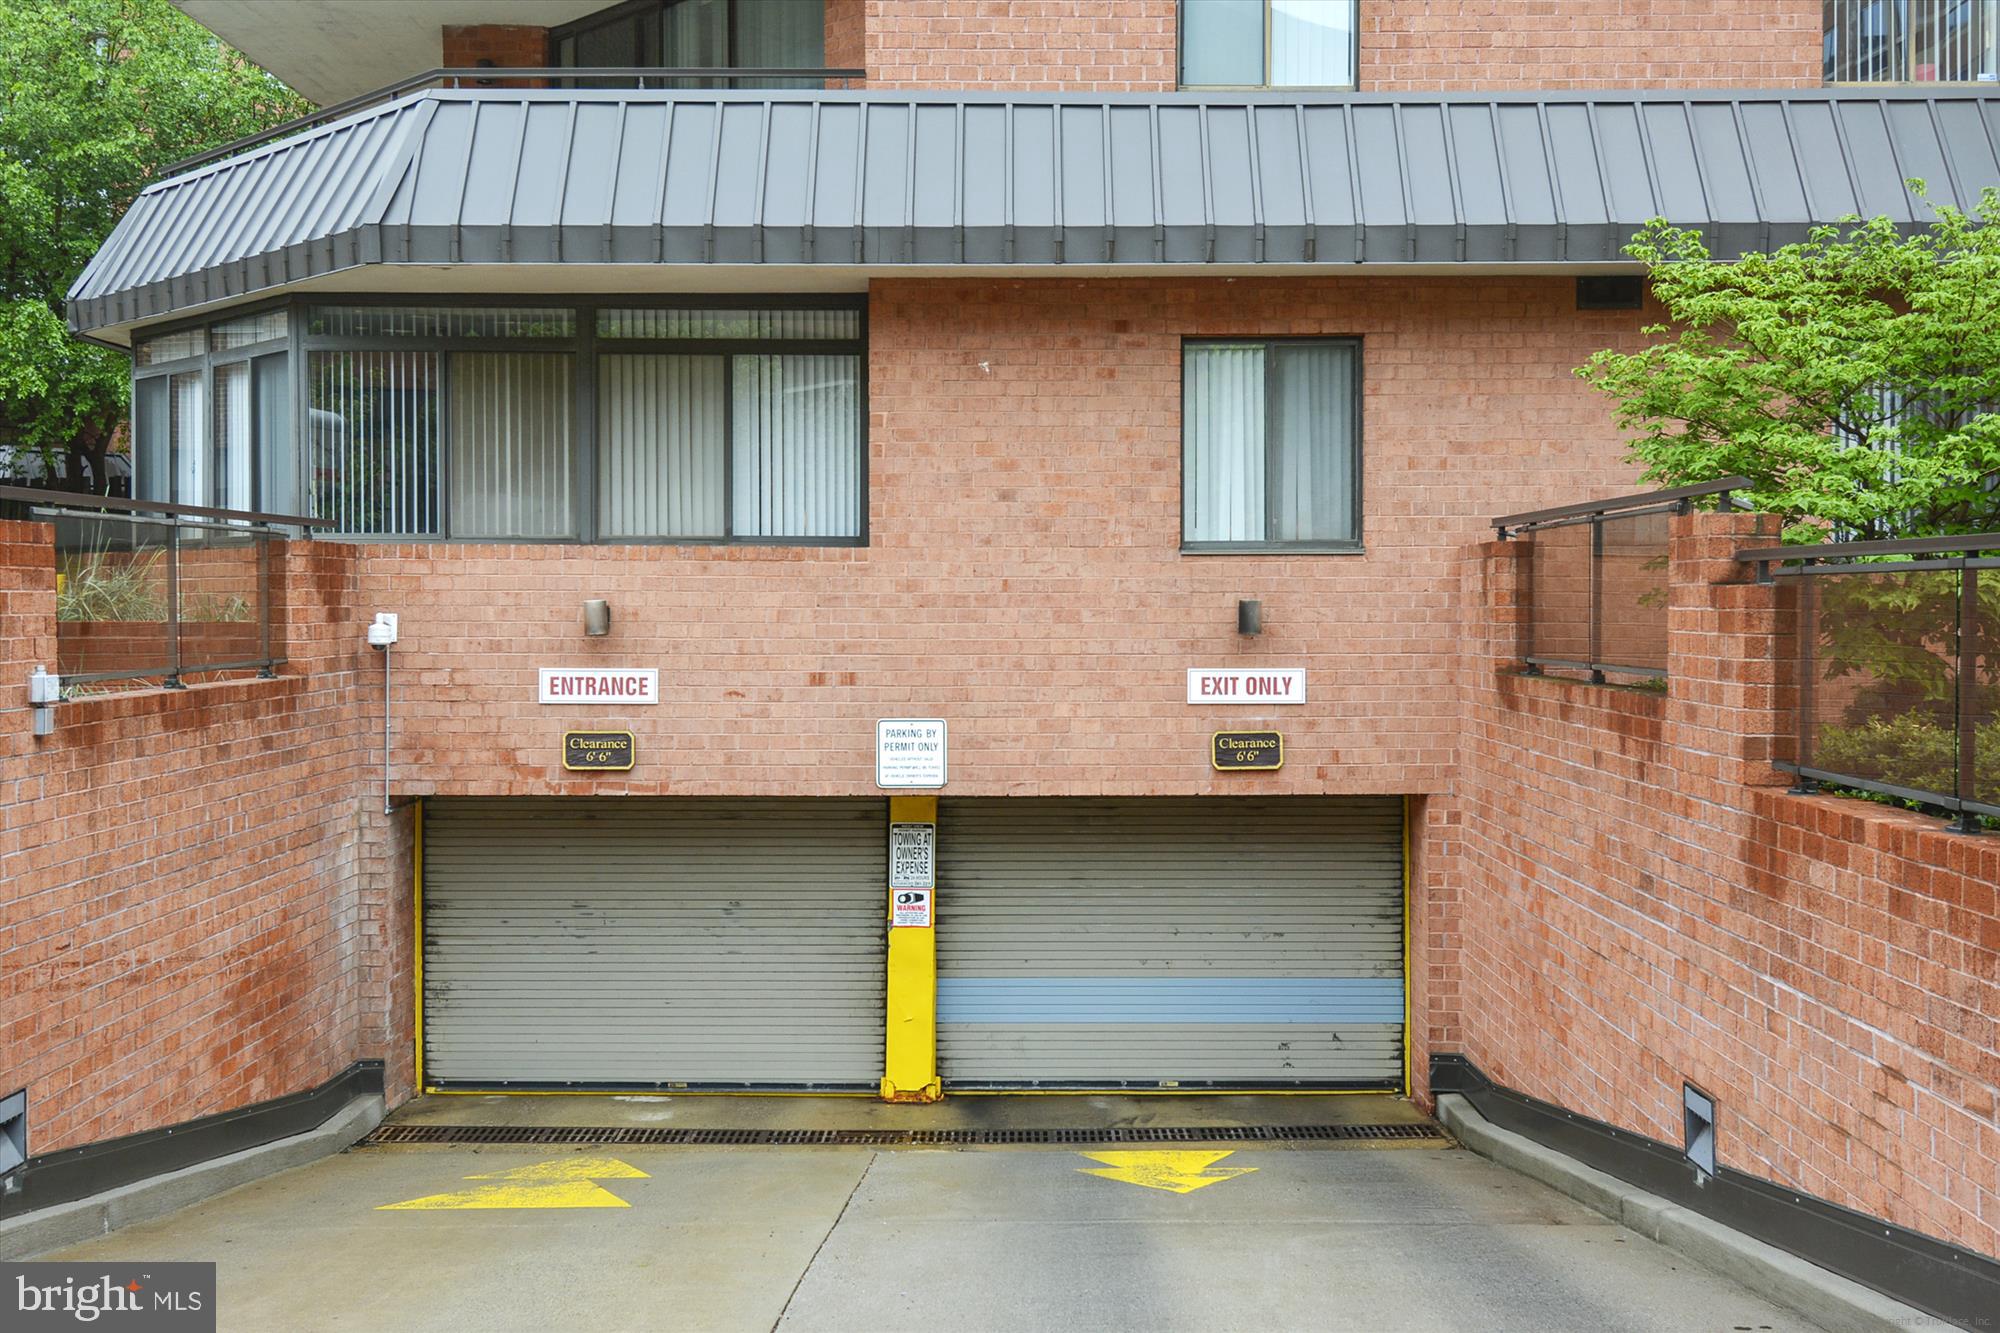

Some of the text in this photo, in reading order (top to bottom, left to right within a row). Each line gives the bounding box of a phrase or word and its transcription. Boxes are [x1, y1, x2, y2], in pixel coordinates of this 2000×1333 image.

[549, 676, 649, 696] ENTRANCE
[1201, 676, 1293, 696] EXIT ONLY
[885, 728, 937, 738] PARKING BY
[569, 737, 628, 749] Clearance
[884, 742, 938, 751] PERMIT ONLY
[1218, 737, 1276, 749] Clearance
[893, 833, 932, 846] TOWING AT
[895, 847, 929, 860] OWNER'S
[895, 861, 929, 874] EXPENSE
